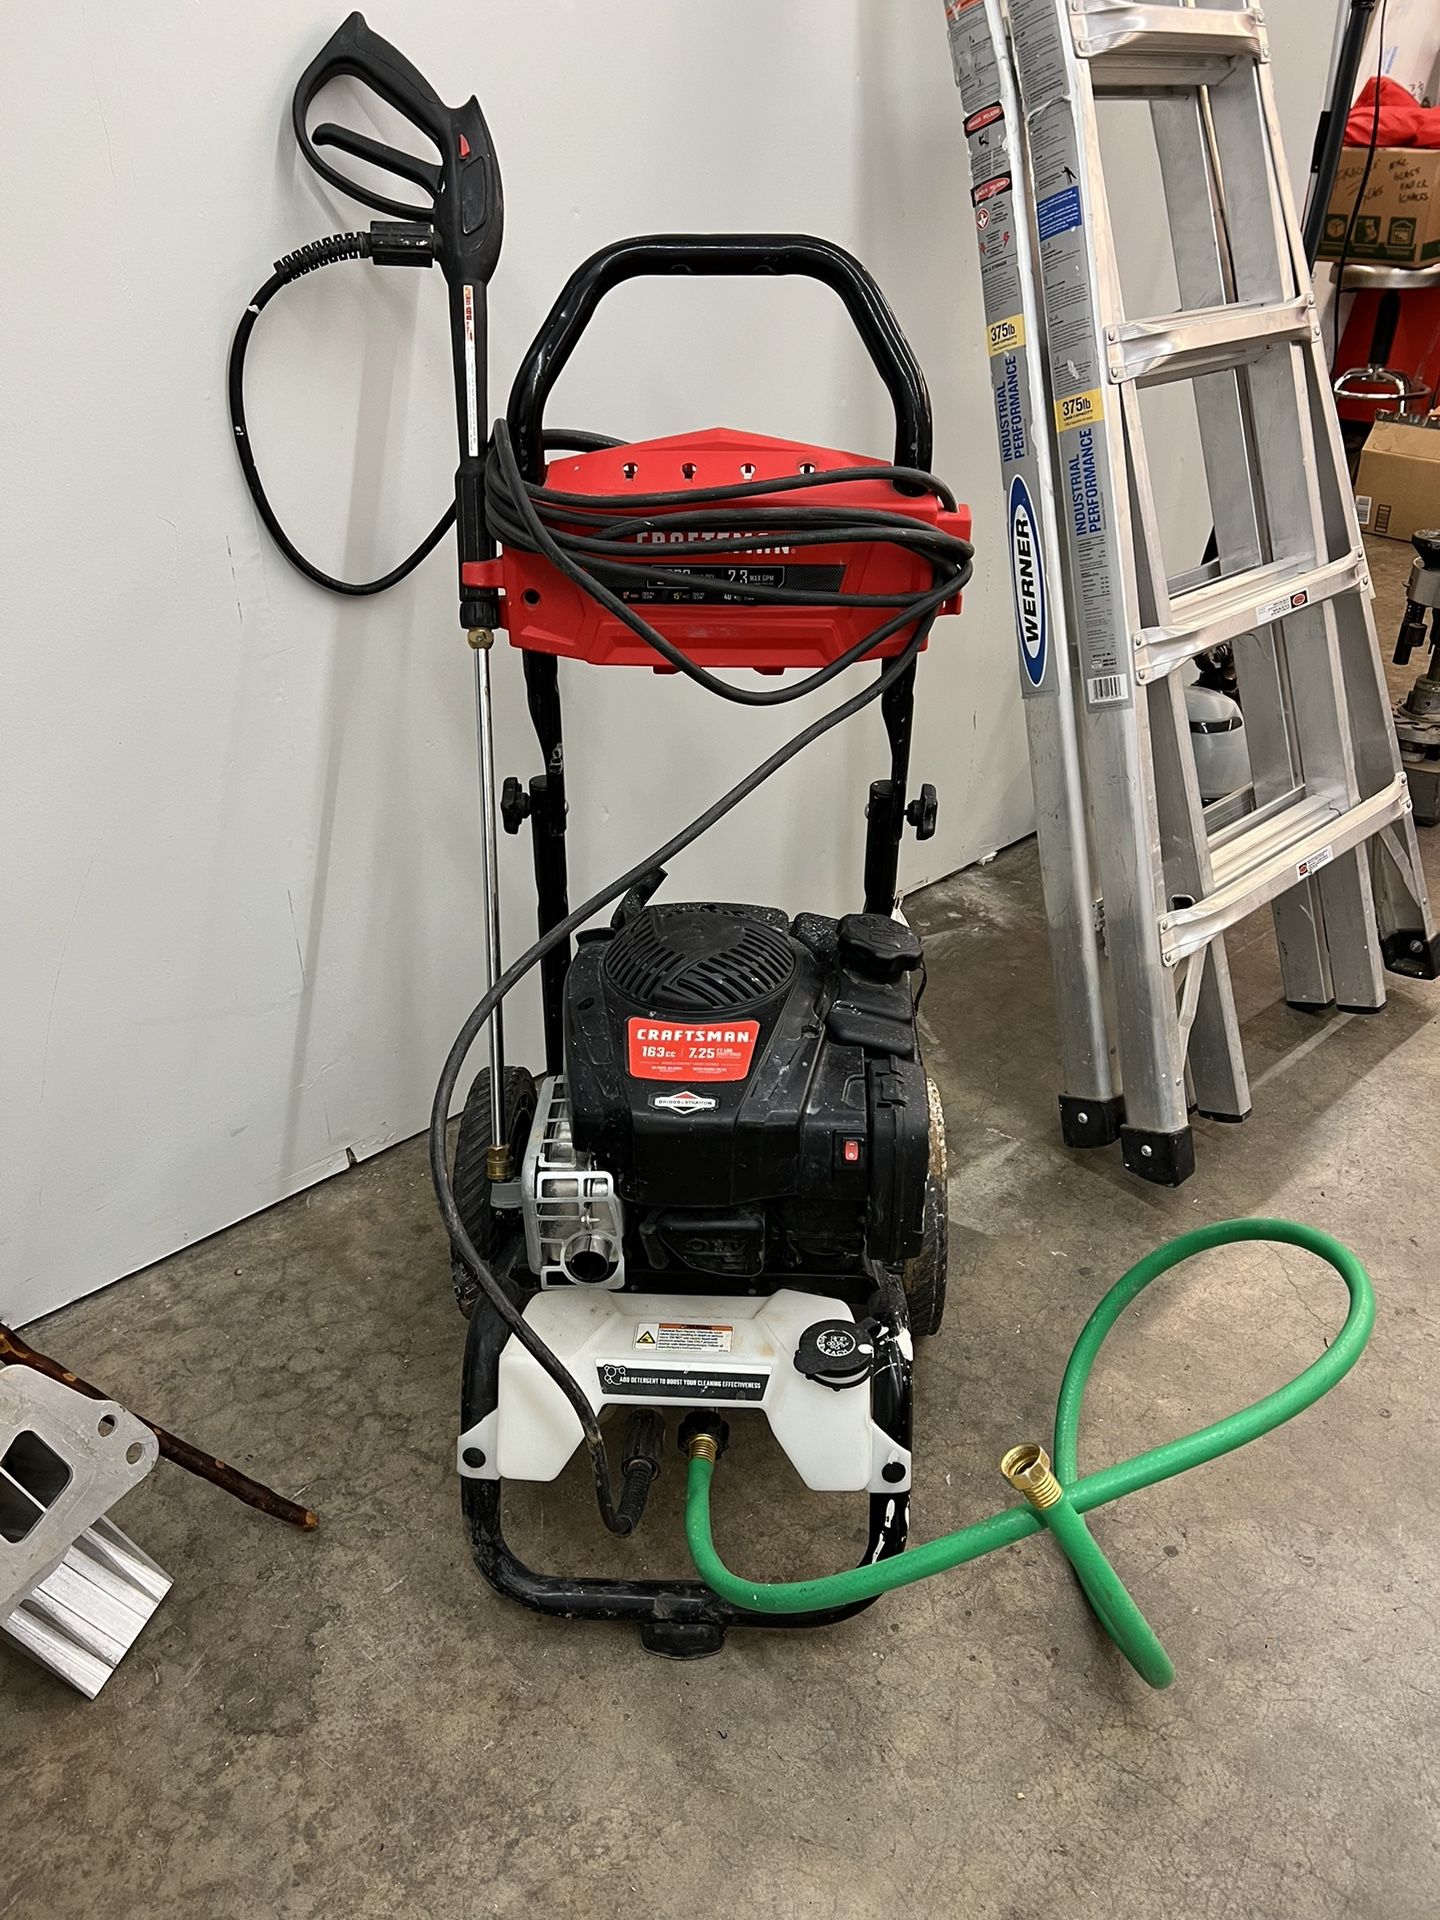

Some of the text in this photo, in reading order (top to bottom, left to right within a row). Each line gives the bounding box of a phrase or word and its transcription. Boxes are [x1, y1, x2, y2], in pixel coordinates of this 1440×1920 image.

[990, 322, 1016, 342] 375lb
[997, 381, 1012, 462] INDUSTRIAL
[1005, 356, 1025, 459] PERFORMANCE
[1062, 397, 1091, 417] 375lb
[1069, 453, 1087, 536] INDUSTRIAL
[1079, 428, 1102, 534] PERFORMANCE
[1013, 517, 1039, 643] WERNER
[637, 1028, 750, 1043] CRAFTSMAN
[642, 1046, 676, 1058] 163cc
[688, 1047, 715, 1059] 7.25
[630, 1376, 659, 1385] DETERGENT
[697, 1379, 722, 1387] CLEANING
[722, 1380, 761, 1389] EFFECTIVENESS
